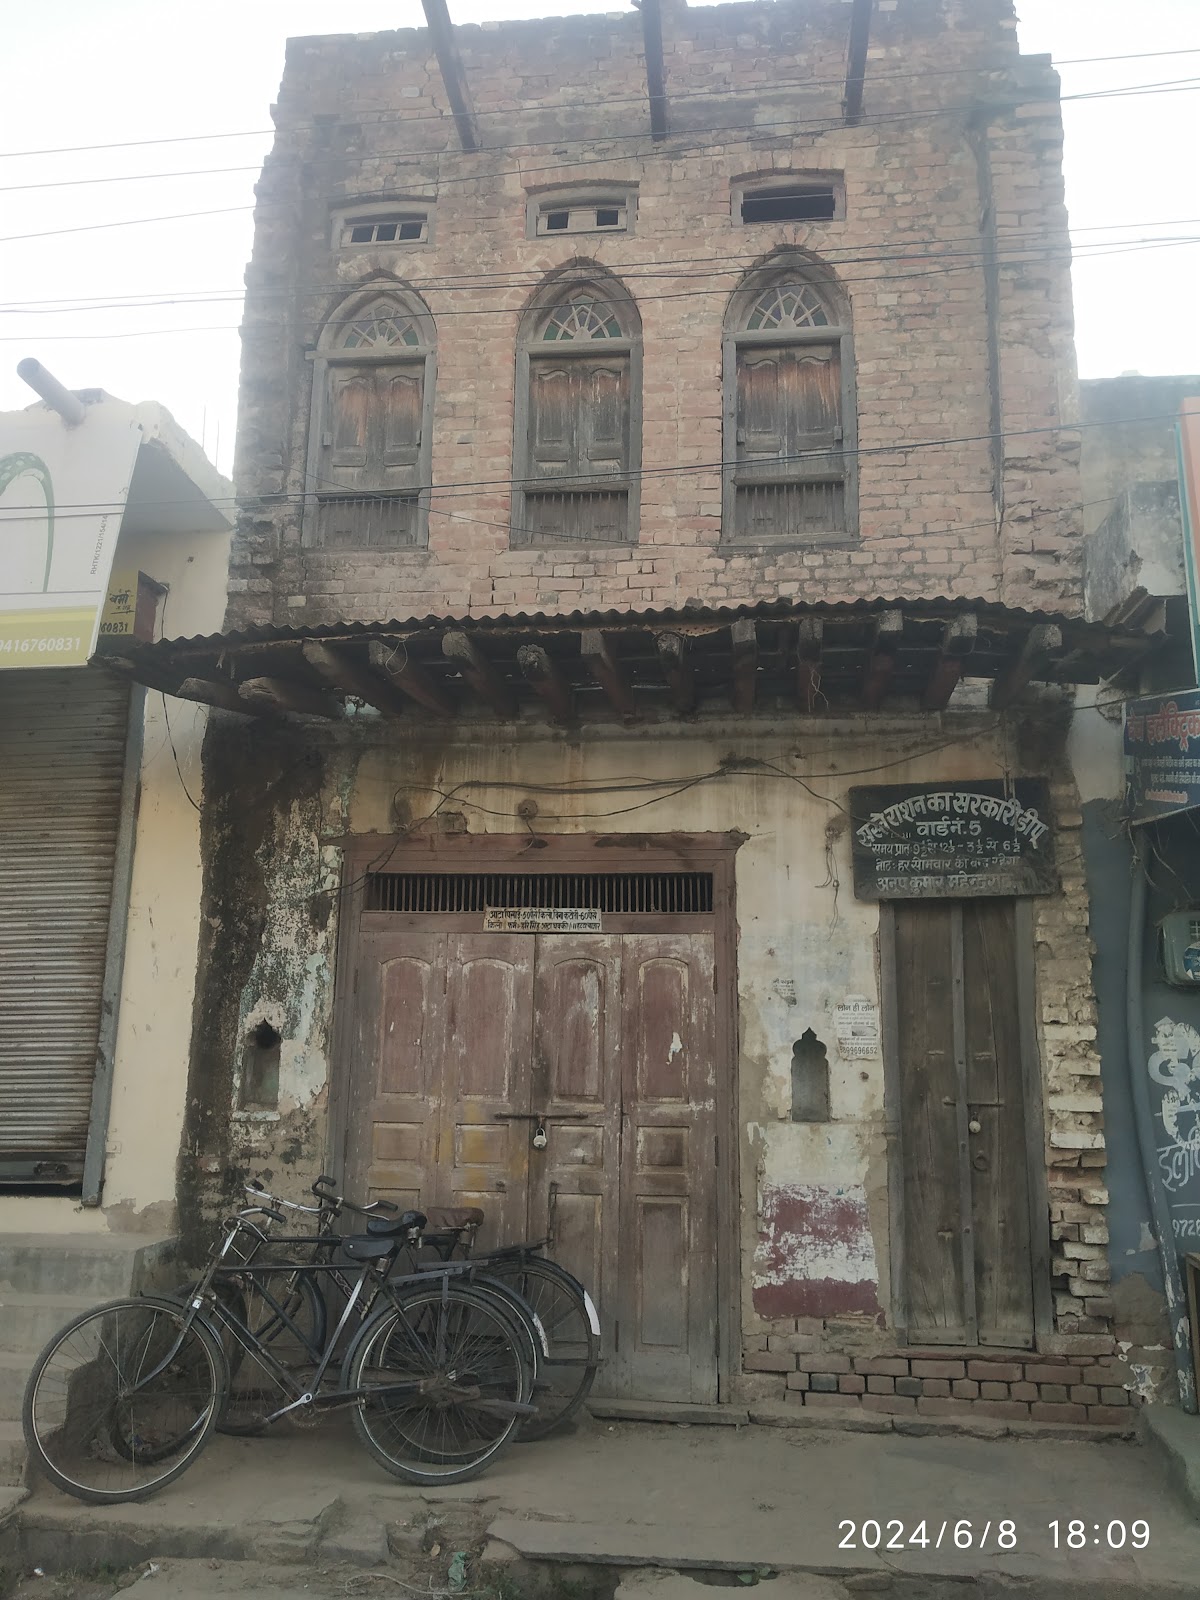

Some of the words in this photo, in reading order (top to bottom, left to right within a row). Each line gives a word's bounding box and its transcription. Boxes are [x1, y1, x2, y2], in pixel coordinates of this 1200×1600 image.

[883, 794, 926, 826] राशन
[926, 791, 954, 811] का
[952, 792, 1024, 827] सरकारी
[916, 815, 951, 837] वार्ड
[969, 820, 982, 836] 5
[872, 843, 893, 856] समय
[837, 1002, 851, 1012] लोन
[852, 1002, 860, 1013] ही
[861, 1002, 875, 1012] लोन
